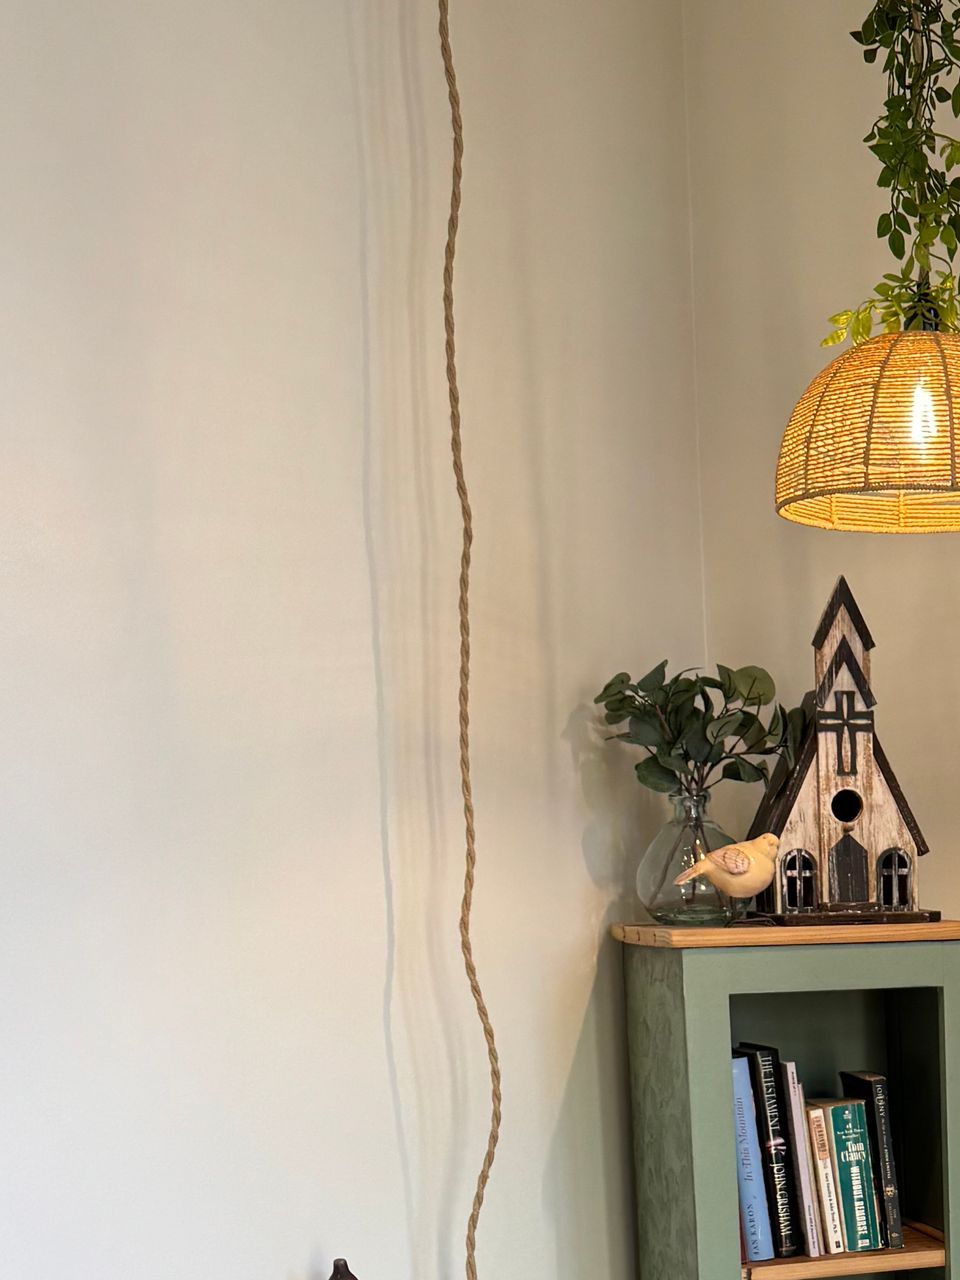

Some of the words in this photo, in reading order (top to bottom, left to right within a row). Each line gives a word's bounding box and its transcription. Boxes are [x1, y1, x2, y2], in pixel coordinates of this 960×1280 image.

[760, 1056, 774, 1076] THE
[763, 1077, 780, 1130] TESTAMENT
[734, 1097, 749, 1144] Mountain
[740, 1147, 751, 1169] This
[840, 1150, 866, 1162] Clancy
[846, 1141, 865, 1152] Tom
[744, 1171, 753, 1182] In
[770, 1163, 787, 1189] JOHN
[850, 1165, 863, 1199] WITHOUT
[746, 1203, 757, 1236] KARON
[776, 1190, 792, 1236] GRISHAM
[855, 1200, 868, 1235] REMORSE
[751, 1239, 760, 1255] JAN
